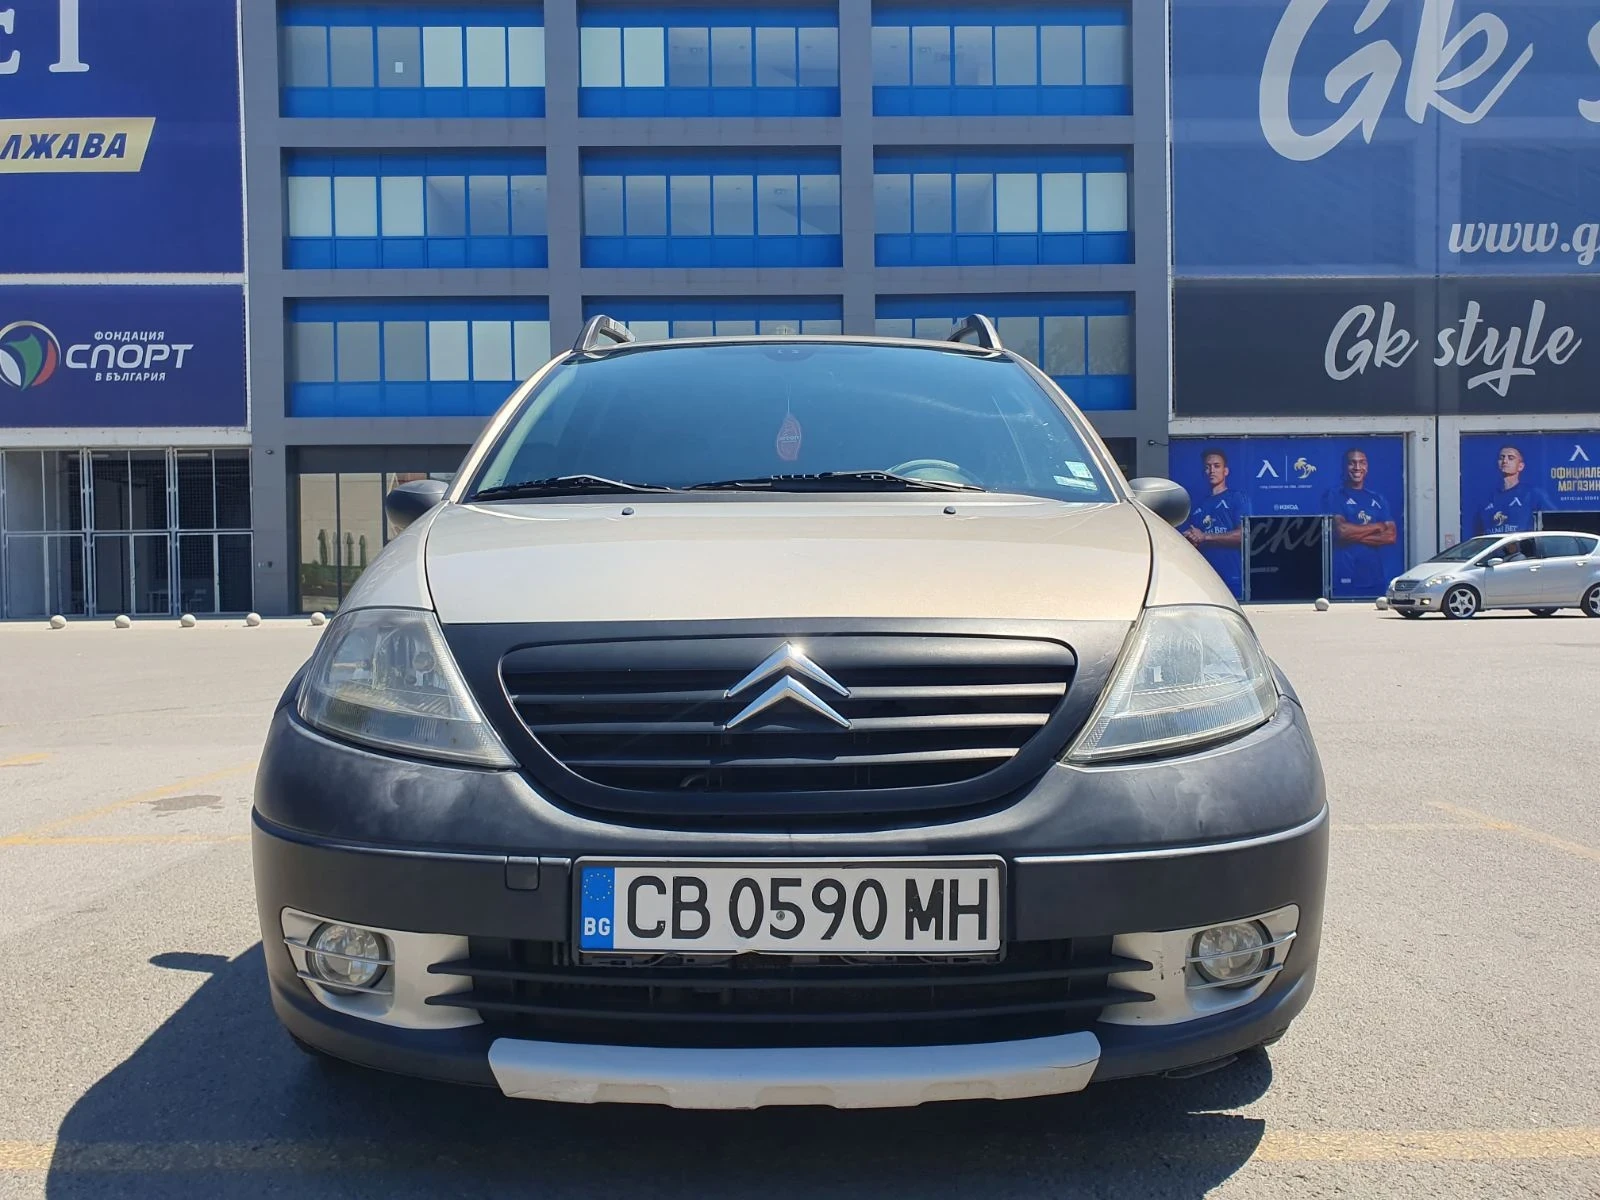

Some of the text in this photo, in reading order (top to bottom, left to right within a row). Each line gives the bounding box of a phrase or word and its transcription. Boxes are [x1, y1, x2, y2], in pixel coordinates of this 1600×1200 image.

[0, 132, 128, 160] ЛЖАВА
[94, 331, 165, 342] ФОНДАЦИЯ
[65, 344, 194, 369] СПОРТ
[1324, 299, 1582, 398] Gk style
[95, 372, 166, 382] В БЪЛГАРИЯ
[1557, 480, 1600, 492] МАГАЗИН
[627, 875, 988, 941] CB 0590 MH
[584, 917, 611, 936] BG
